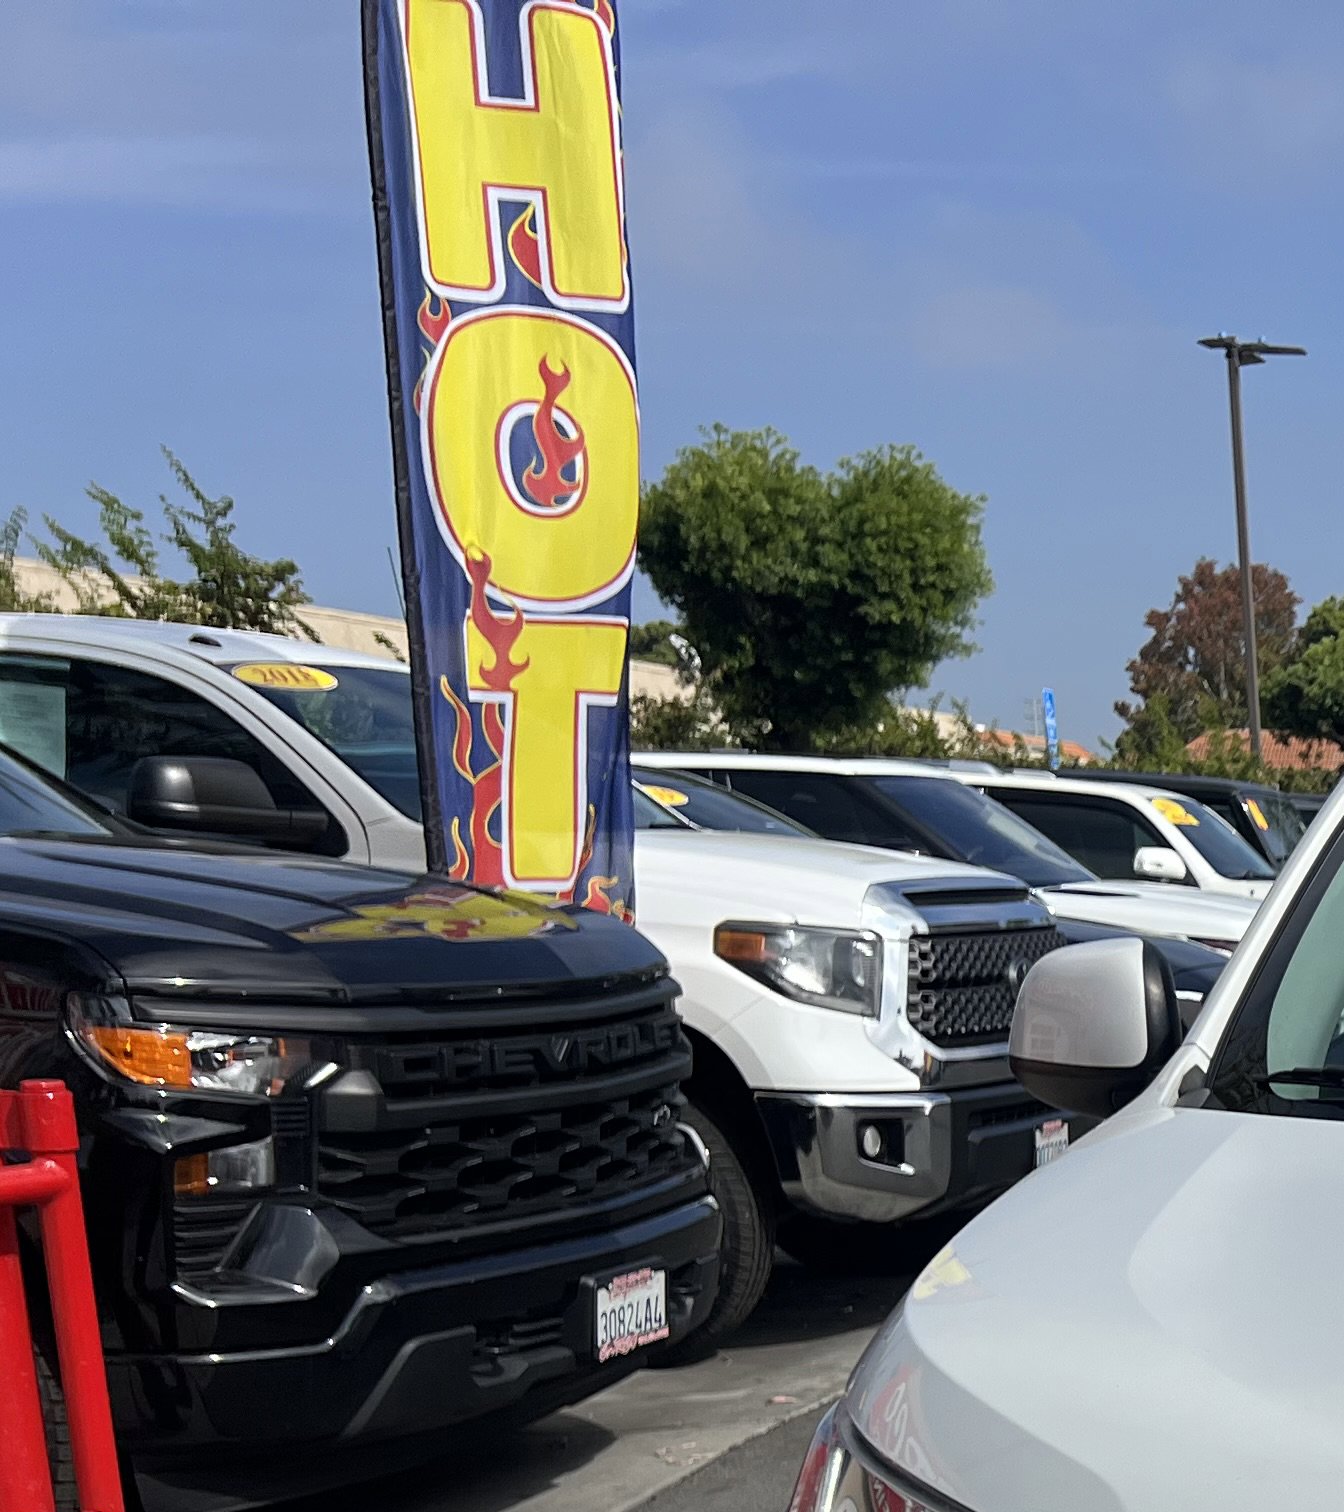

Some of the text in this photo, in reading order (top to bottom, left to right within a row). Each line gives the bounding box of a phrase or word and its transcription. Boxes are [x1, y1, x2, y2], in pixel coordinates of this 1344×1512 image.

[400, 0, 641, 893] HOT
[374, 1018, 683, 1084] CHEVROLE
[600, 1293, 662, 1345] 30824A4
